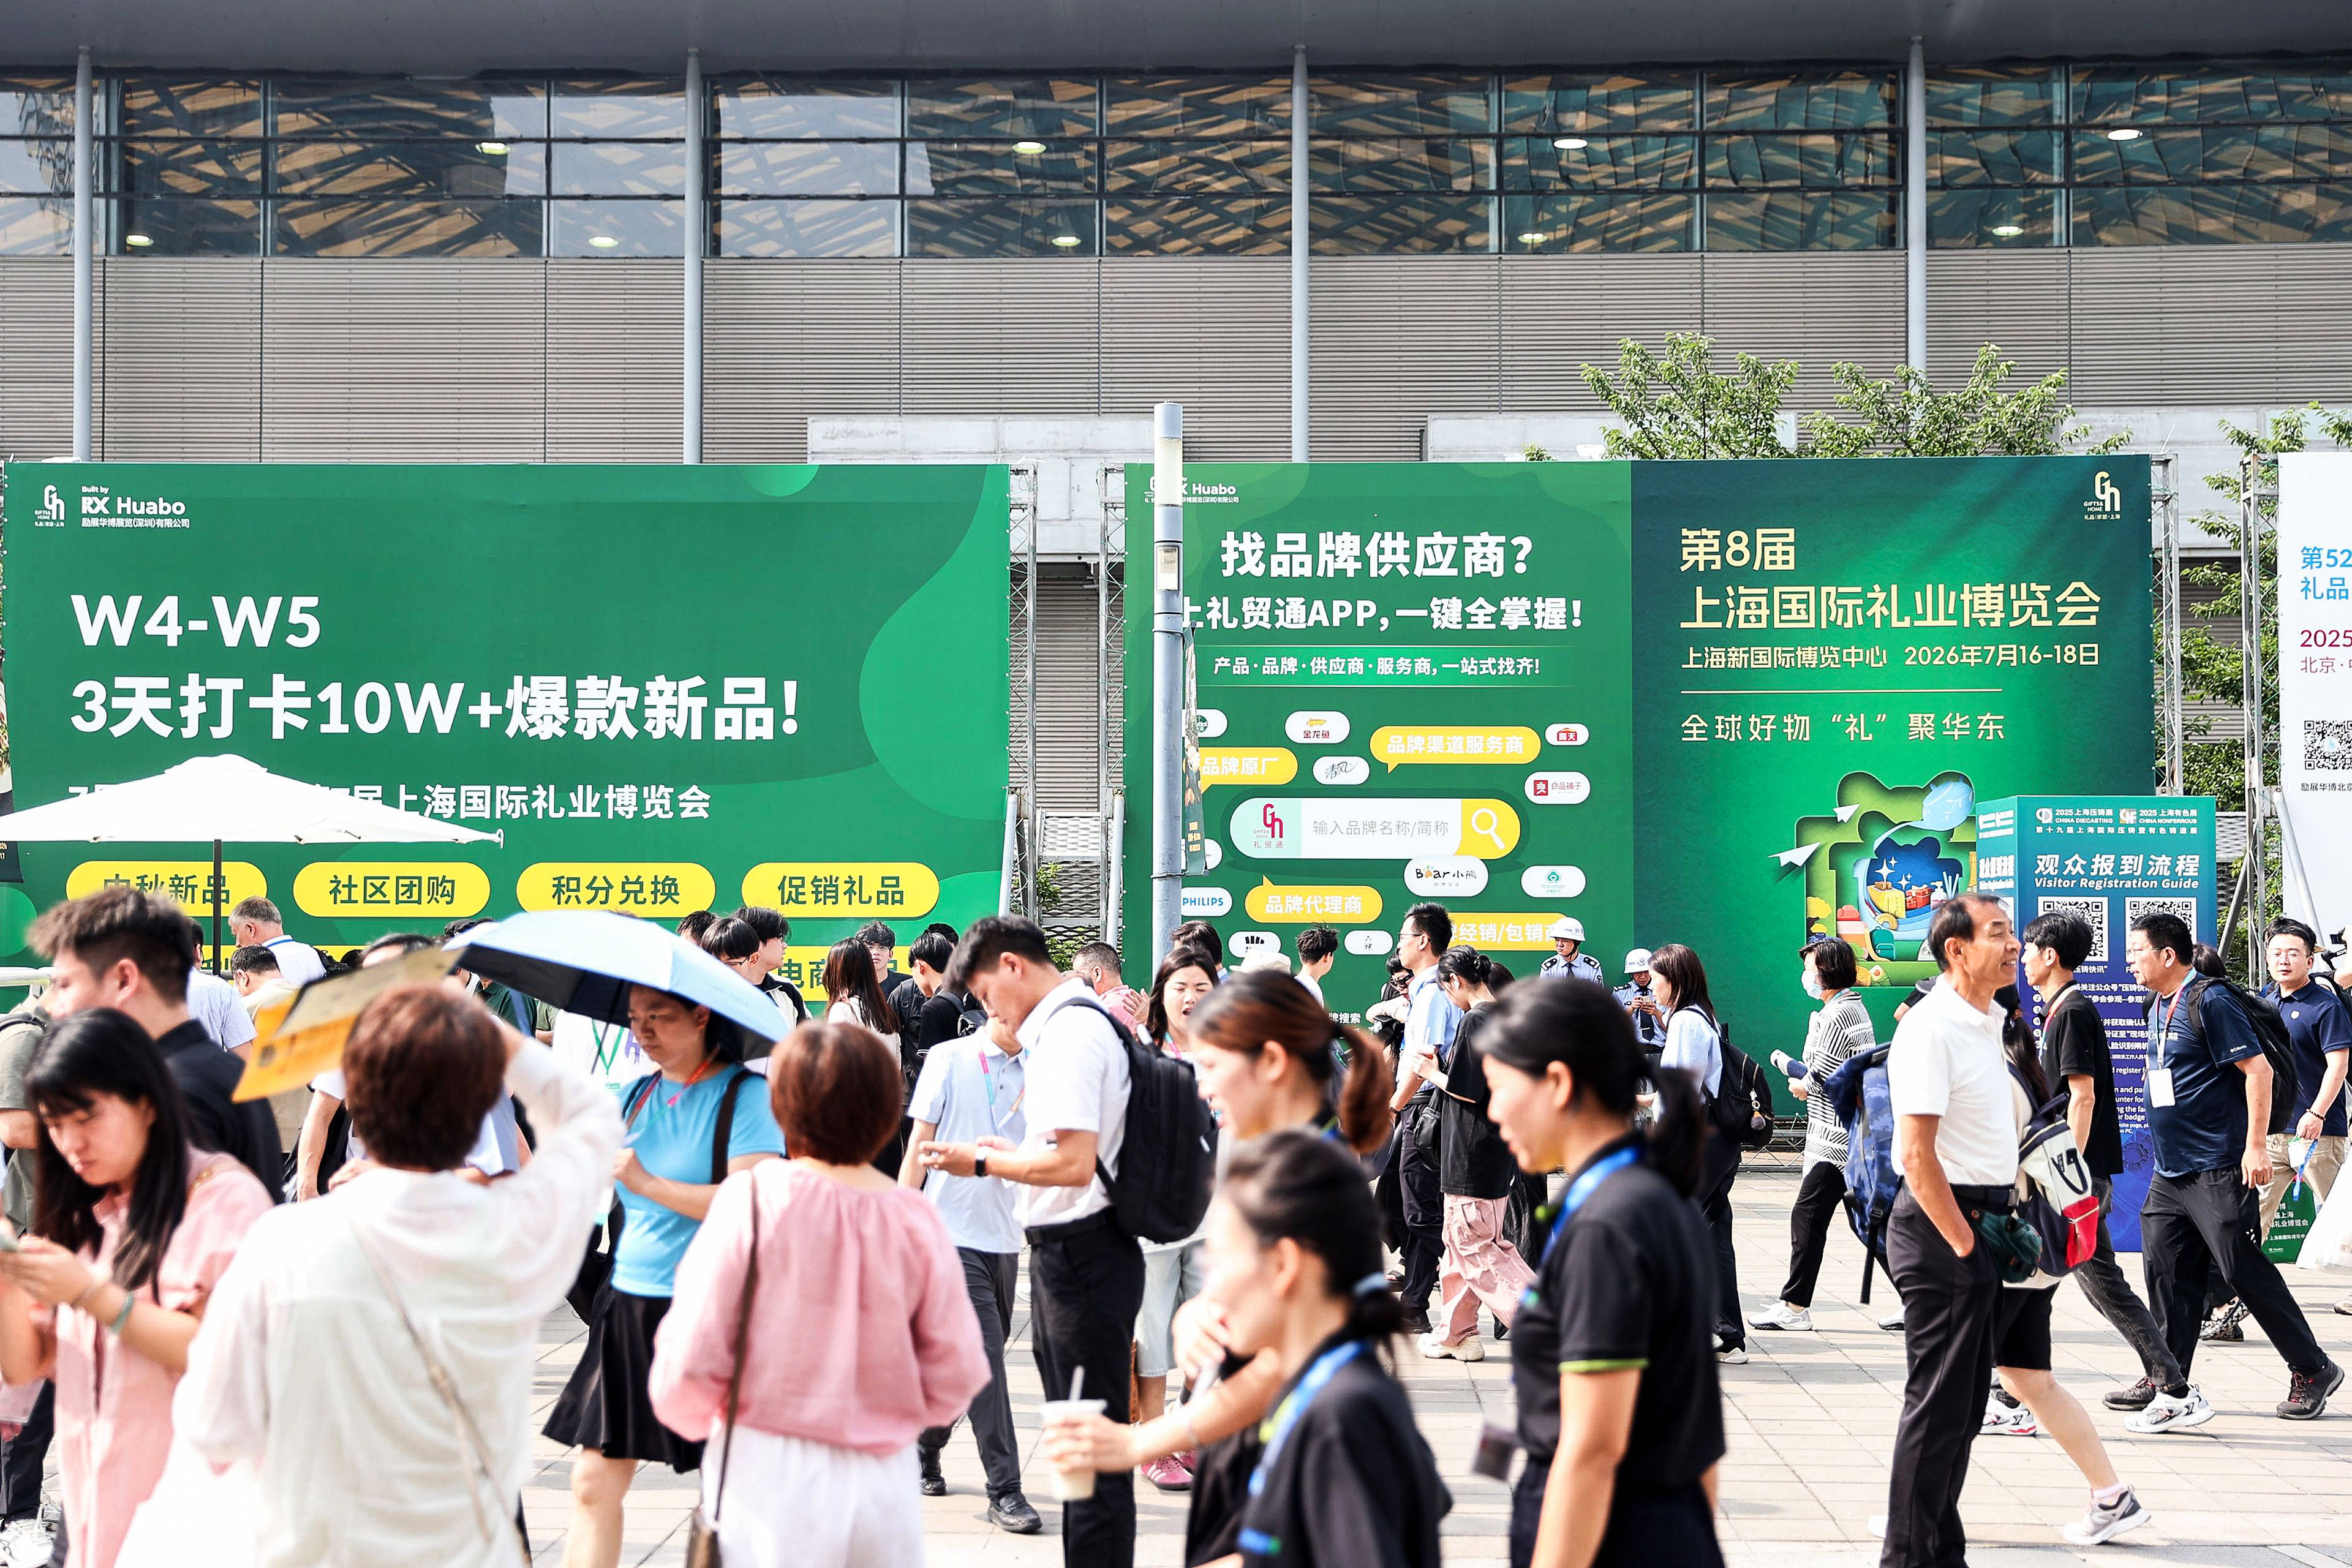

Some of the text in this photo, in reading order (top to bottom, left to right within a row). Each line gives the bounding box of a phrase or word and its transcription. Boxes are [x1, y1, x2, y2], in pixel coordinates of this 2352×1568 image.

[1193, 483, 1237, 495] Huabo
[81, 496, 186, 514] RX Huabo
[1220, 530, 1534, 579] 找品牌供应商?
[1680, 527, 1795, 571] 第8届
[1680, 581, 2101, 629] 上海国际礼业博览会
[70, 594, 321, 648] W4-W5
[2300, 630, 2352, 647] 2025
[1681, 643, 2099, 669] 上海新国际博览中心 2026年7月16-18日
[2301, 656, 2352, 674] 北京·
[70, 673, 799, 741] 3天打卡10W+爆款新品!
[1303, 730, 1330, 739] 金龙鱼
[1680, 713, 1811, 742] 全球好物
[1907, 712, 2005, 742] 聚华东
[1387, 736, 1524, 755] 品牌渠道服务商
[1202, 756, 1279, 775] 品牌原厂
[1551, 782, 1581, 790] 良品铺子
[1313, 820, 1449, 837] 输入品牌名称/简称
[2034, 853, 2200, 876] 观众报到流程
[329, 875, 456, 905] 社区团购
[551, 874, 680, 906] 积分兑换
[777, 874, 905, 906] 促销礼品
[2034, 877, 2199, 891] Visitor Registration Guide
[1182, 897, 1224, 906] PHILIPS
[1265, 895, 1362, 915] 品牌代理商
[2116, 1066, 2141, 1075] register
